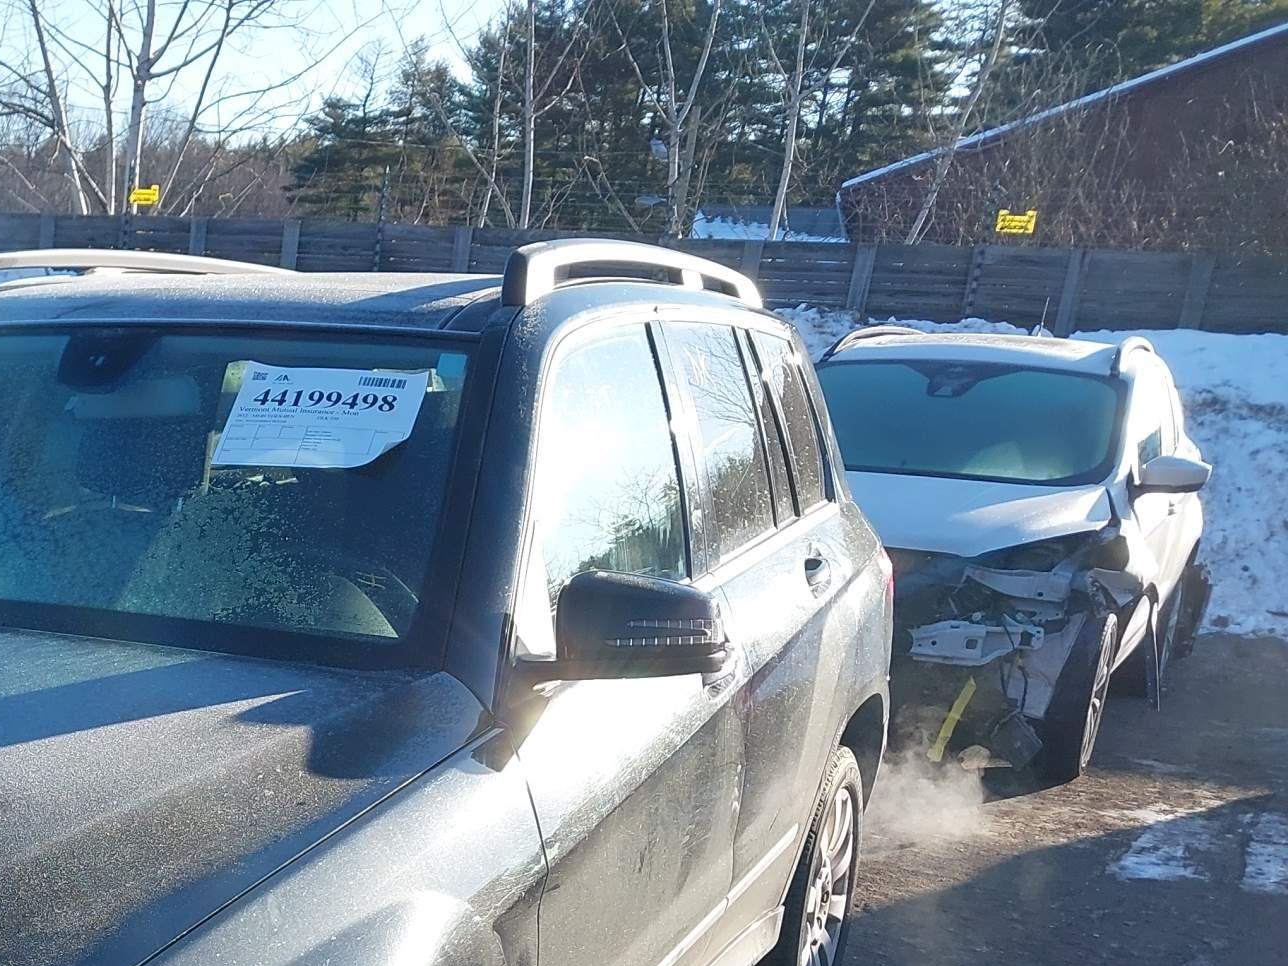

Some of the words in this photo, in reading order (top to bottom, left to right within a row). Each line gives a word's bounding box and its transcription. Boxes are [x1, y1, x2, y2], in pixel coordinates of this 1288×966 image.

[253, 388, 398, 413] 44199498
[239, 406, 270, 414] Vermont
[271, 407, 298, 415] Mutual
[299, 408, 335, 416] Insurance
